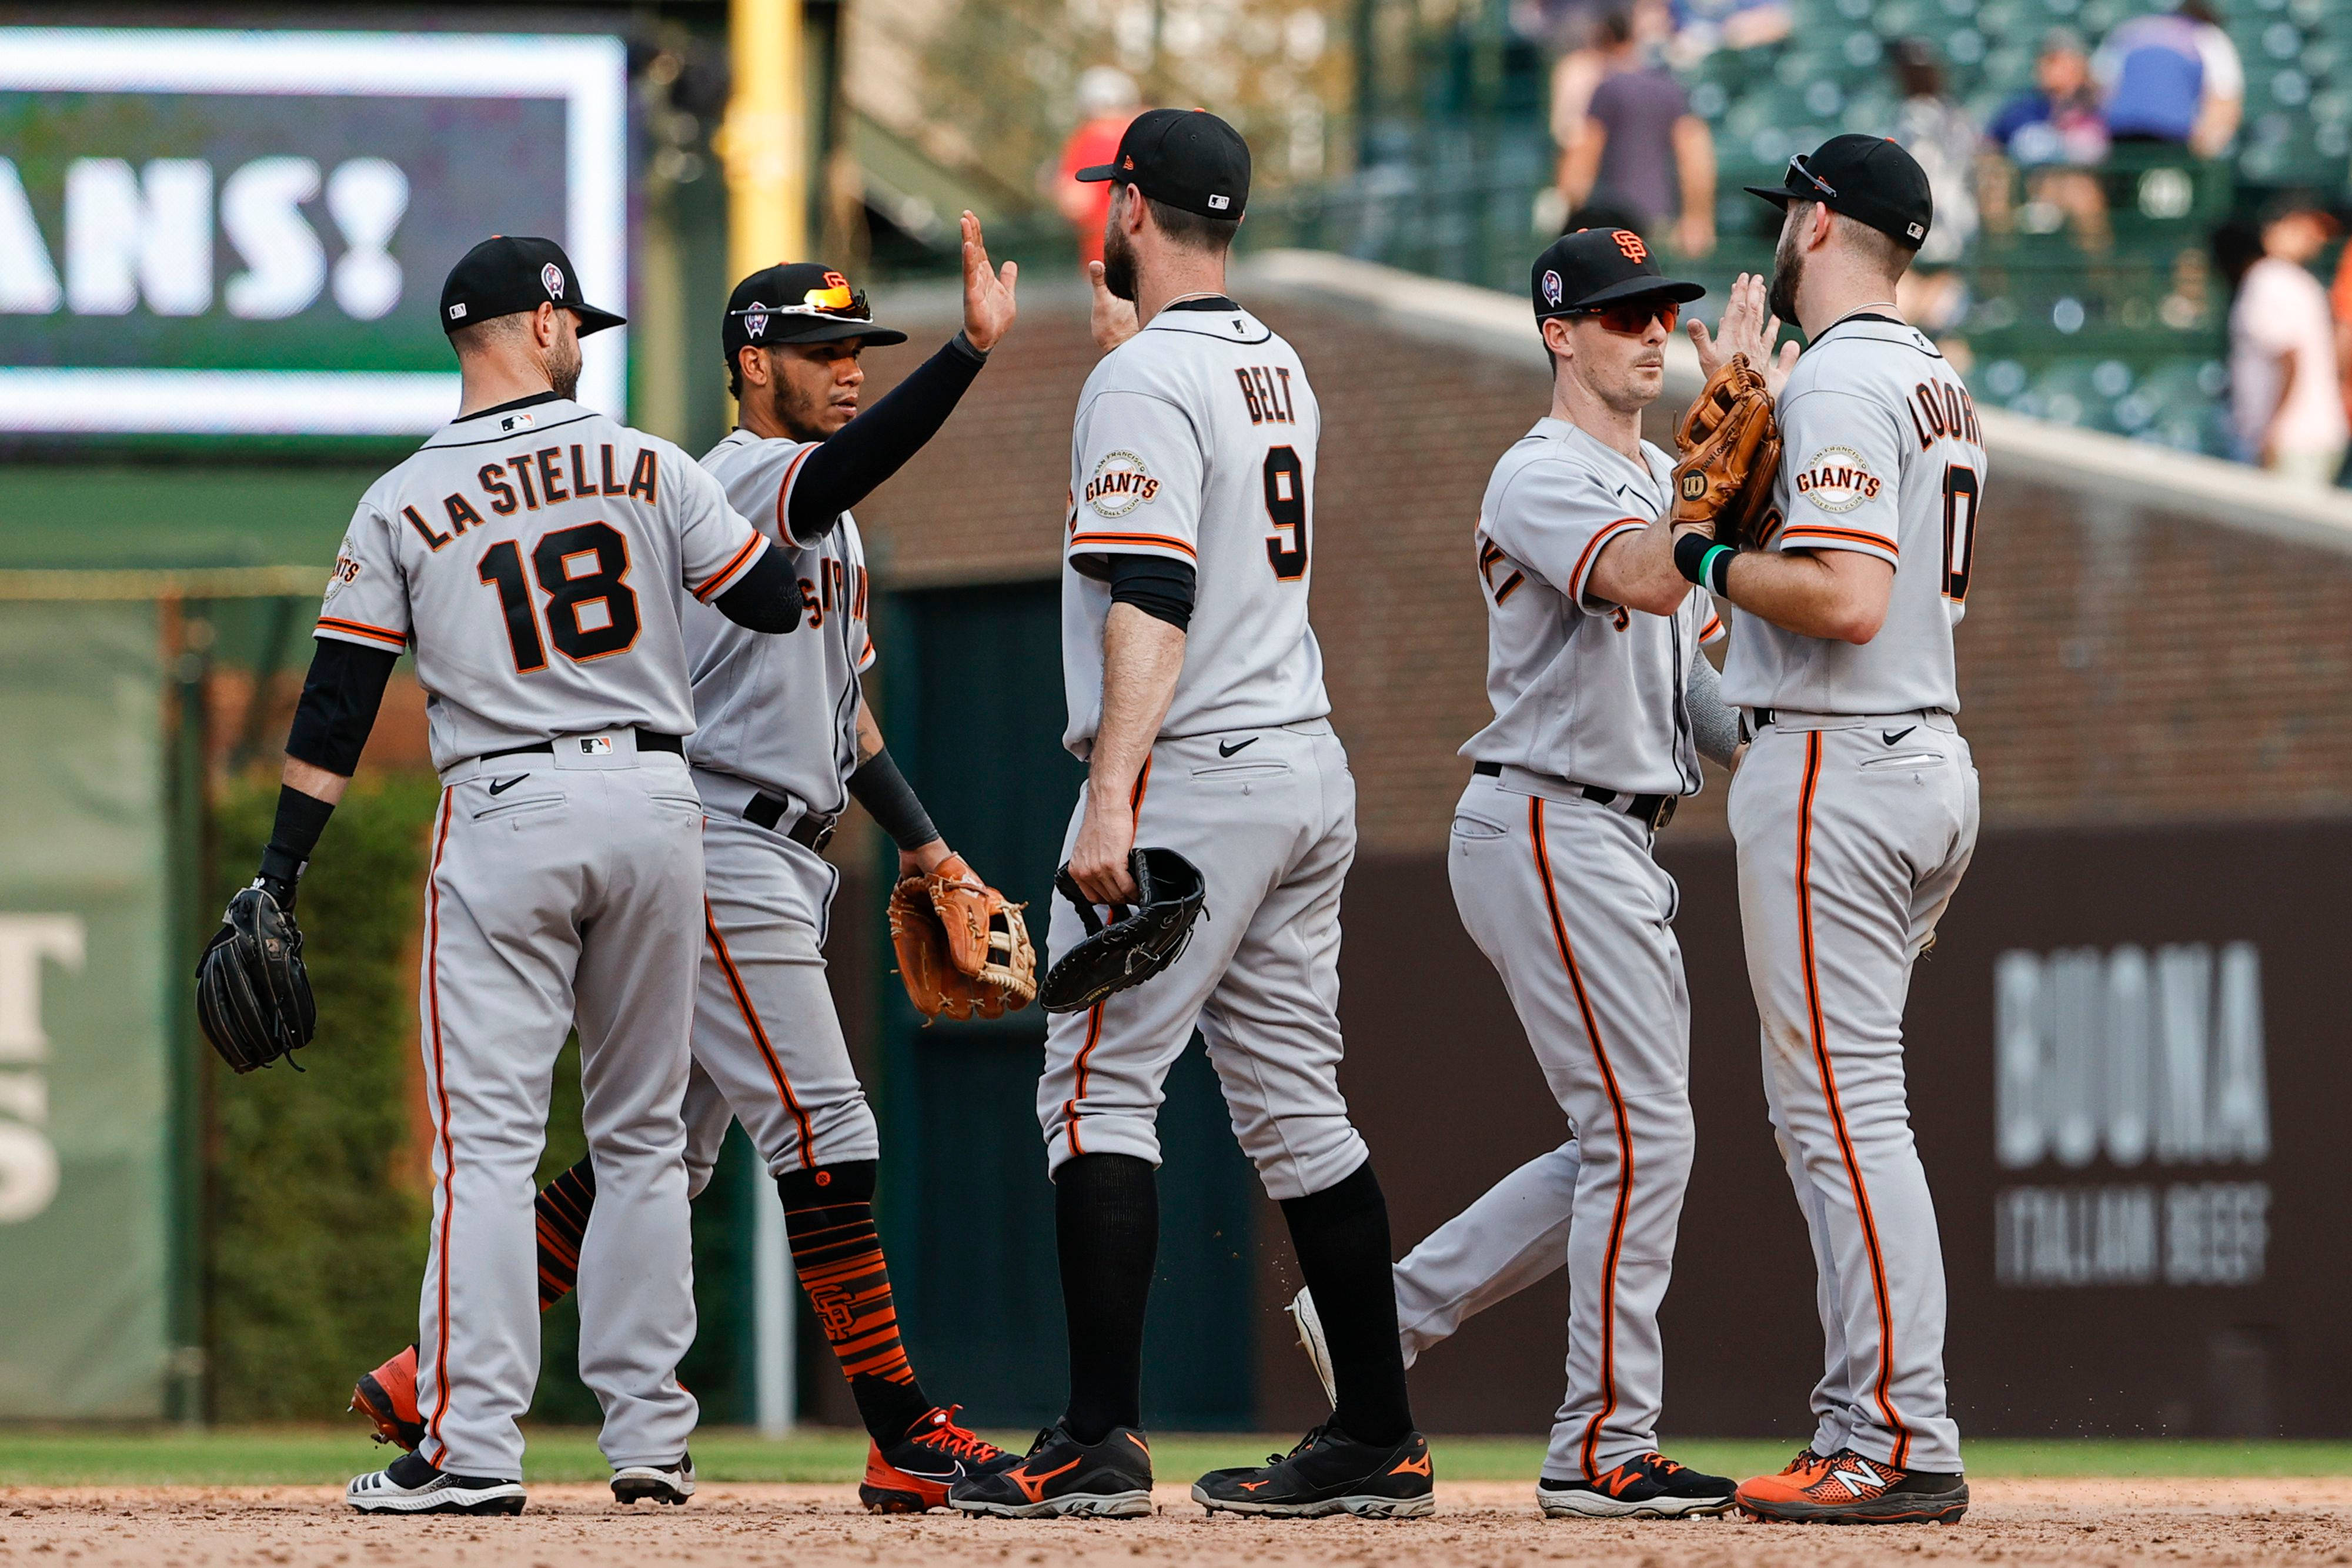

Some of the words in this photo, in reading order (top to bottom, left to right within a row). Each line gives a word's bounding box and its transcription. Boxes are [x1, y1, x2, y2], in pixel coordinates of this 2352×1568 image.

[1234, 366, 1295, 425] BELT
[1106, 451, 1145, 472] FRANCISCO
[1810, 452, 1823, 466] SAN
[1825, 446, 1867, 469] FRANCISCO
[401, 493, 486, 553] LA
[477, 444, 658, 516] STELLA
[1085, 472, 1160, 503] GIANTS
[1795, 467, 1882, 499] GIANTS
[1262, 444, 1309, 582] 9
[476, 520, 642, 675] 18
